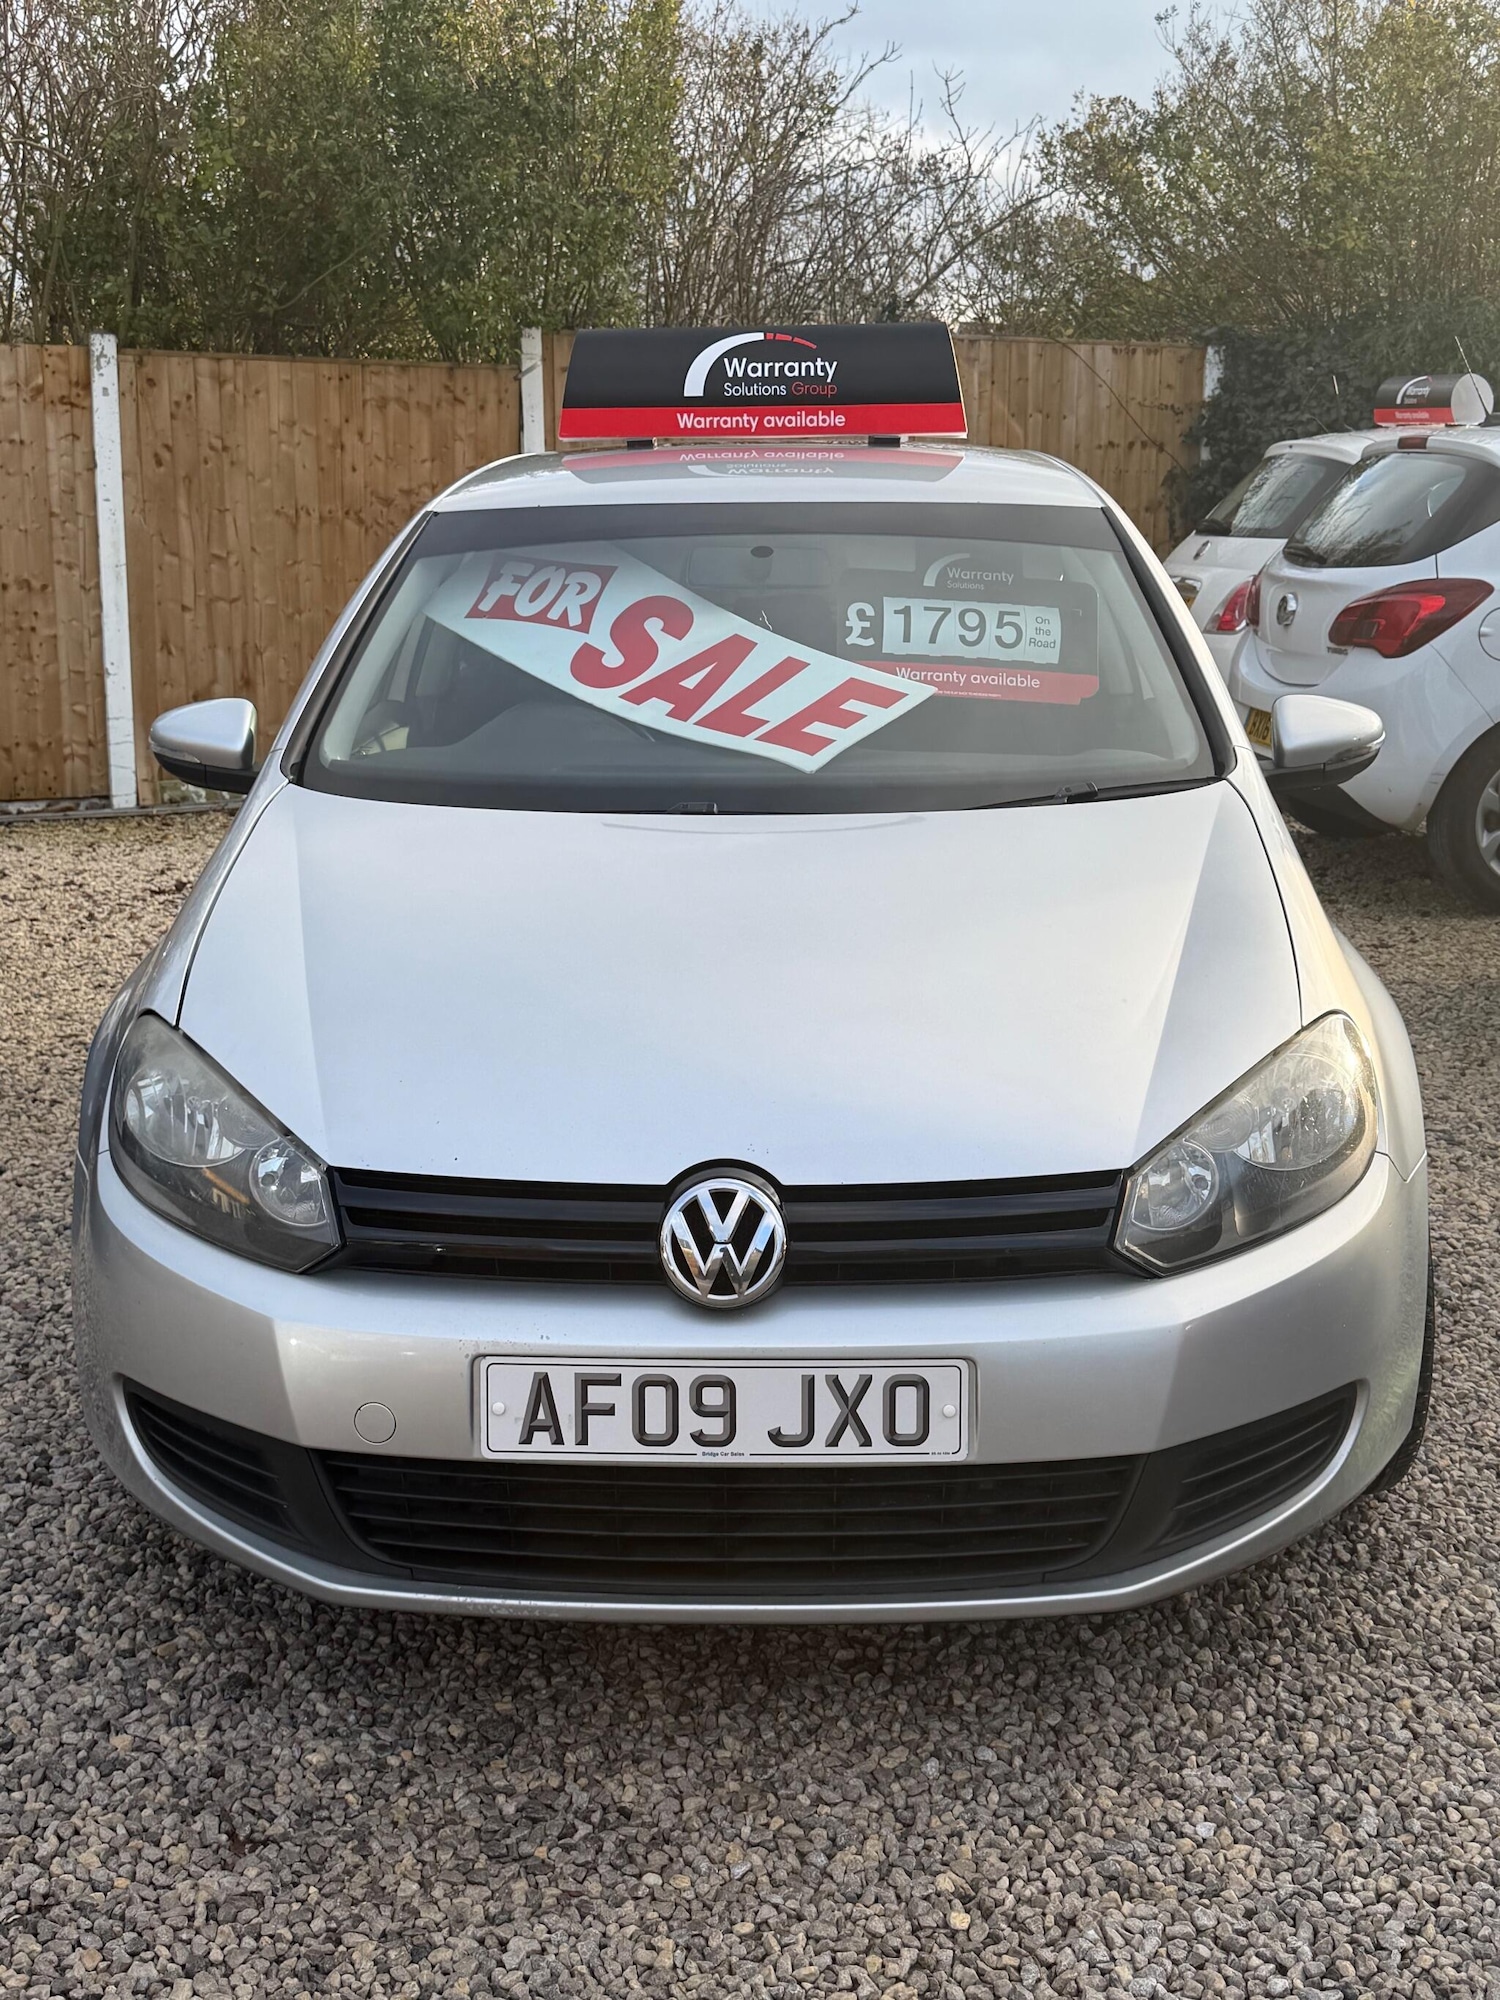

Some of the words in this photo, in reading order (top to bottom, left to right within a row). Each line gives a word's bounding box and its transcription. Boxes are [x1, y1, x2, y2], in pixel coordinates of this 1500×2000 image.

[724, 357, 838, 382] Warranty
[724, 382, 787, 397] Solutions
[791, 382, 838, 397] Group
[676, 412, 759, 432] Warranty
[763, 411, 846, 429] available
[947, 567, 1014, 586] Warranty
[947, 580, 985, 591] Solutions
[845, 602, 1023, 650] £1795
[1035, 616, 1050, 625] On
[1034, 627, 1051, 637] the
[1028, 639, 1056, 649] Road
[480, 561, 602, 628] FOR
[570, 595, 909, 757] SALE
[896, 667, 967, 687] Warranty
[970, 672, 1041, 689] available
[518, 1371, 737, 1447] AF09
[767, 1373, 931, 1448] JXO
